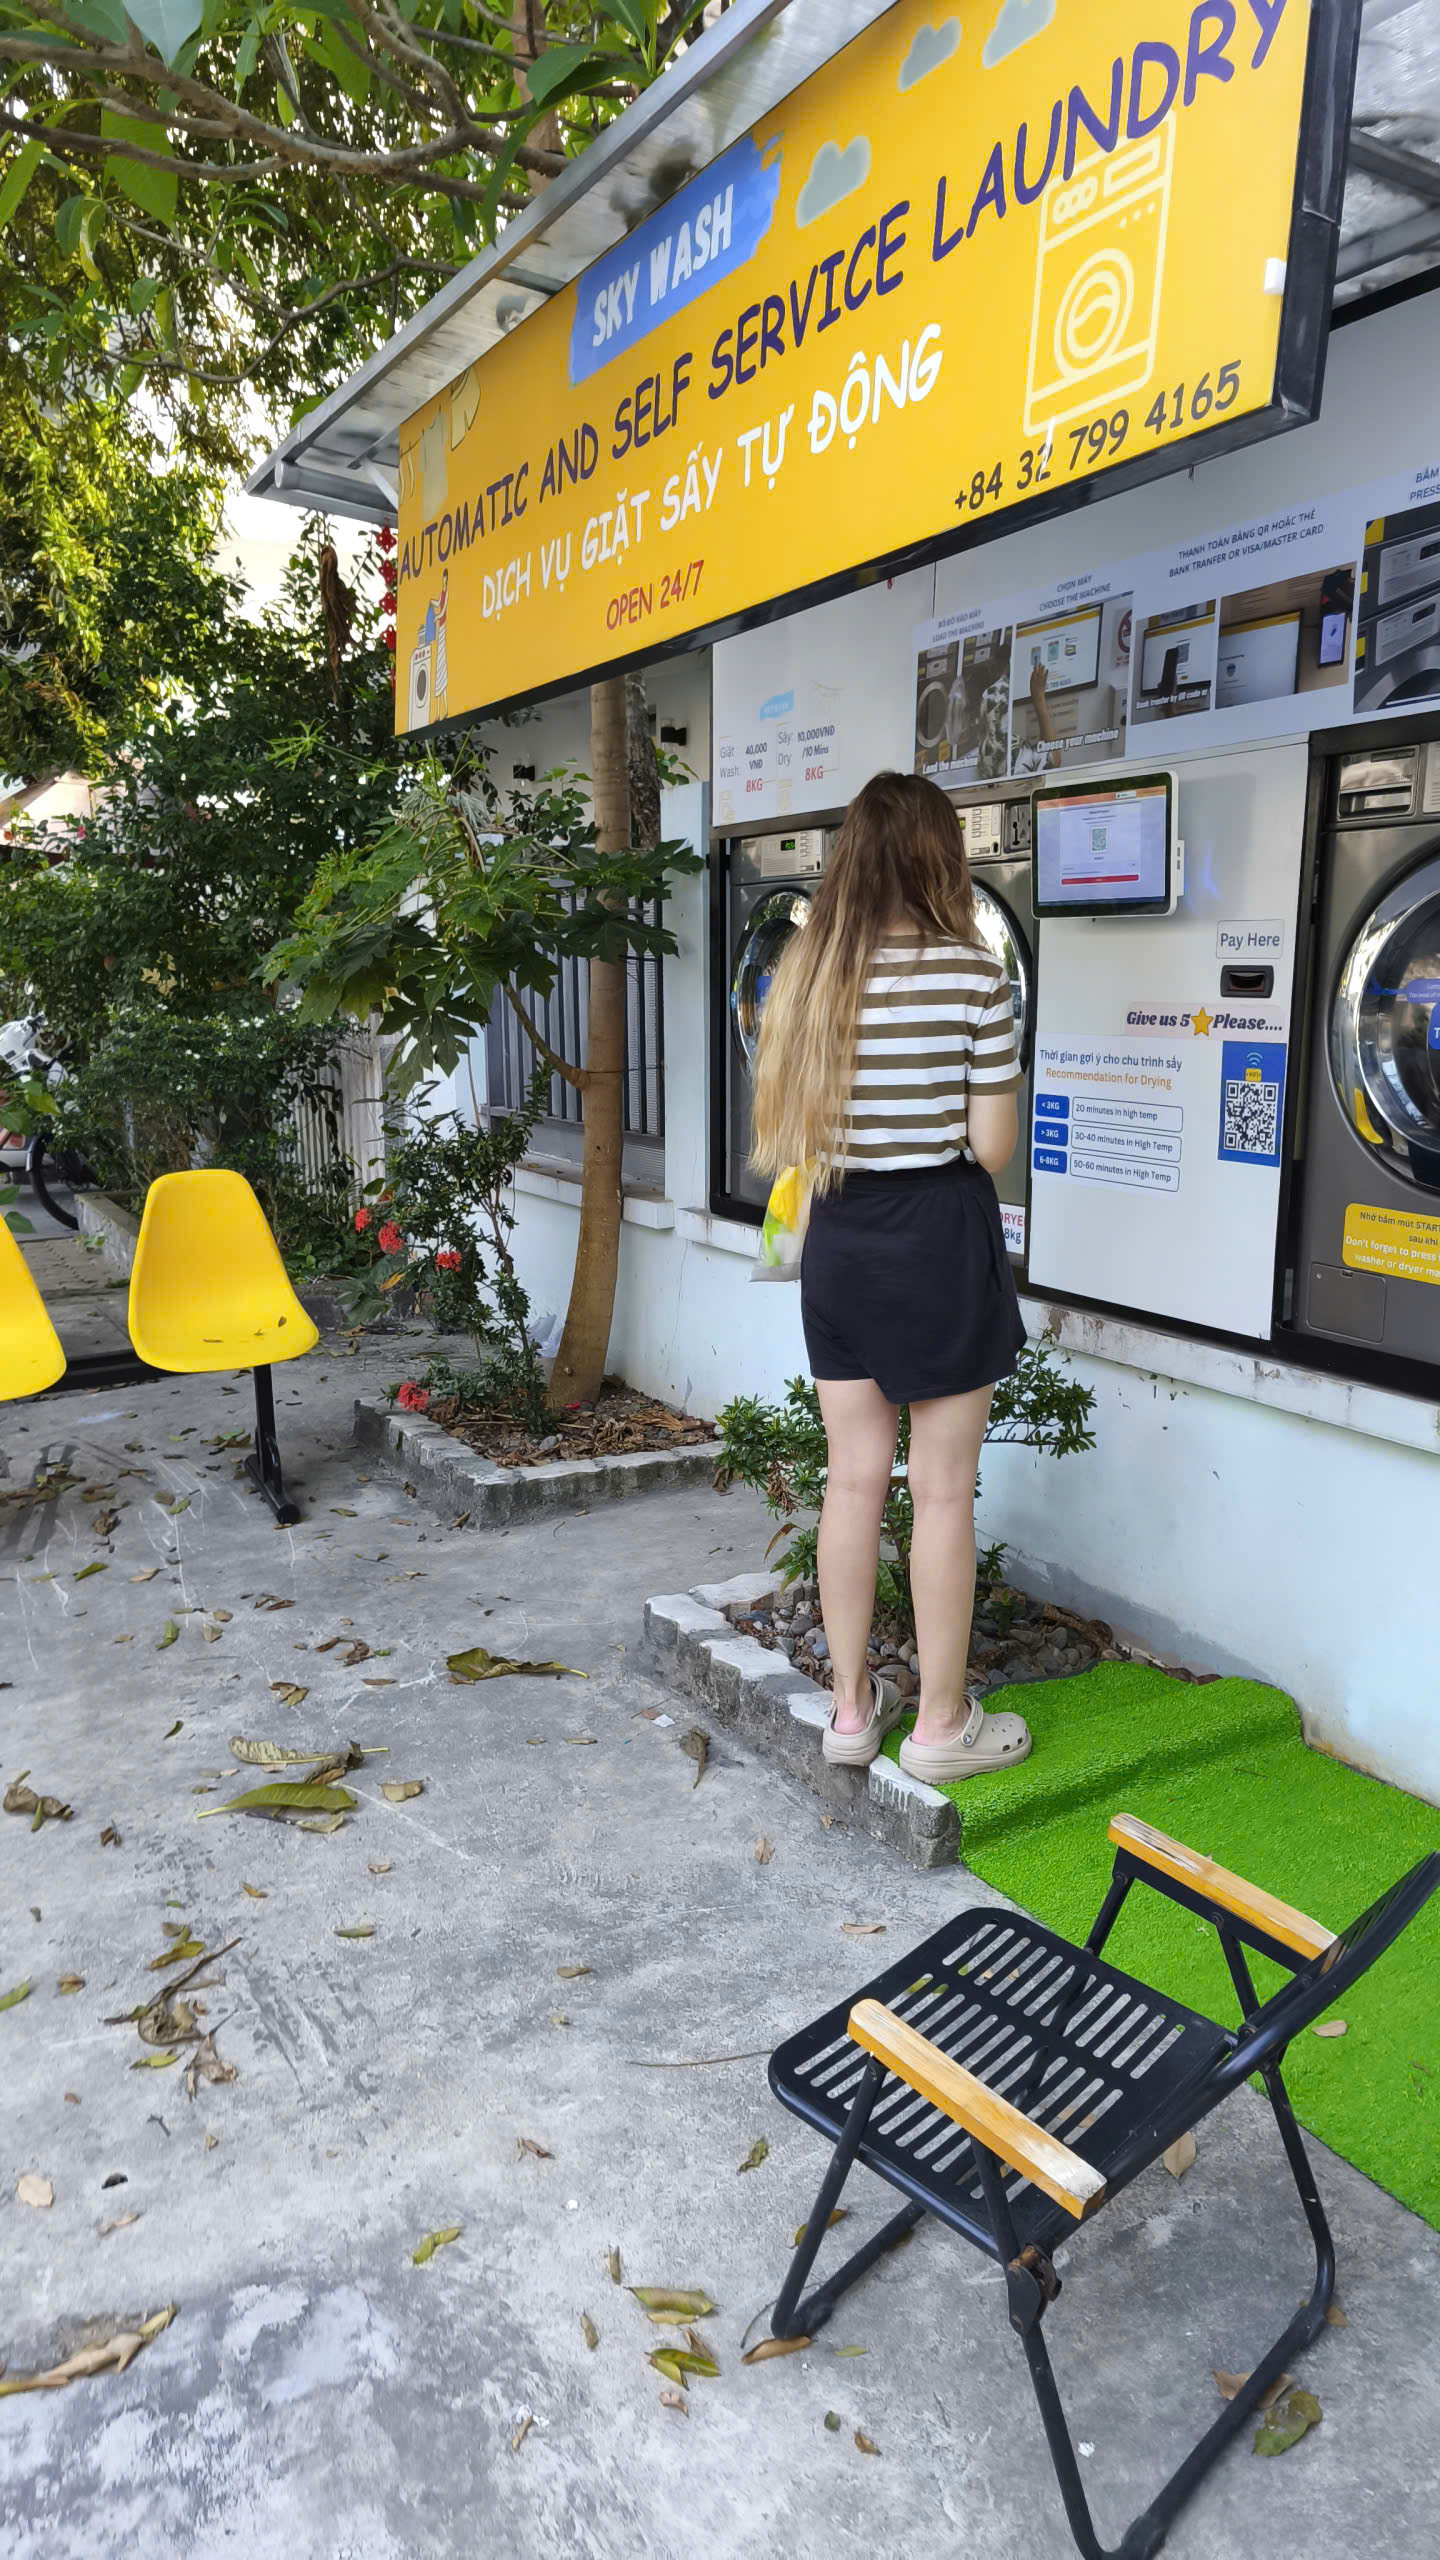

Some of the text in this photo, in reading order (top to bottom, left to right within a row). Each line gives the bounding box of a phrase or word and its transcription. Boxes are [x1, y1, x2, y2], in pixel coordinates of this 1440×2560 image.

[592, 184, 734, 347] SKY WASH
[398, 0, 1287, 585] AUTOMATIC AND SELF SERVICE LAUNDRY
[954, 359, 1242, 510] +84 32 799 4165
[481, 323, 944, 622] DỊCH VỤ GIẶT SẤY TỰ ĐỘNG
[1169, 523, 1324, 578] BANK TRANFER OR VISA/MASTER CARD
[1178, 543, 1206, 560] THANH
[1257, 525, 1270, 537] QR
[606, 559, 704, 631] OPEN 24/7
[1039, 581, 1111, 612] CHOOSE THE MACHINE
[1036, 727, 1119, 753] Choose your machine
[804, 765, 824, 781] 8KG
[746, 777, 763, 793] 8KG
[1220, 932, 1280, 951] Pay Here
[1126, 1010, 1283, 1031] Give us 5 Please....
[1039, 1049, 1183, 1072] Thời gian gợi ý cho chu trình sấy
[1045, 1067, 1172, 1090] Recommendation for Drying
[1075, 1103, 1158, 1122] 20 minutes in high temp
[1075, 1131, 1173, 1153] 30-40 minutes in High Temp
[1039, 1156, 1059, 1167] 6-8KG
[1073, 1159, 1171, 1183] 50-60 minutes in High Temp
[1004, 1227, 1021, 1245] 8kg
[1408, 1234, 1438, 1246] sau khi
[1345, 1235, 1437, 1262] Don't forget to press
[1353, 1254, 1385, 1266] washer
[1386, 1260, 1397, 1269] or
[1398, 1262, 1424, 1275] dryer
